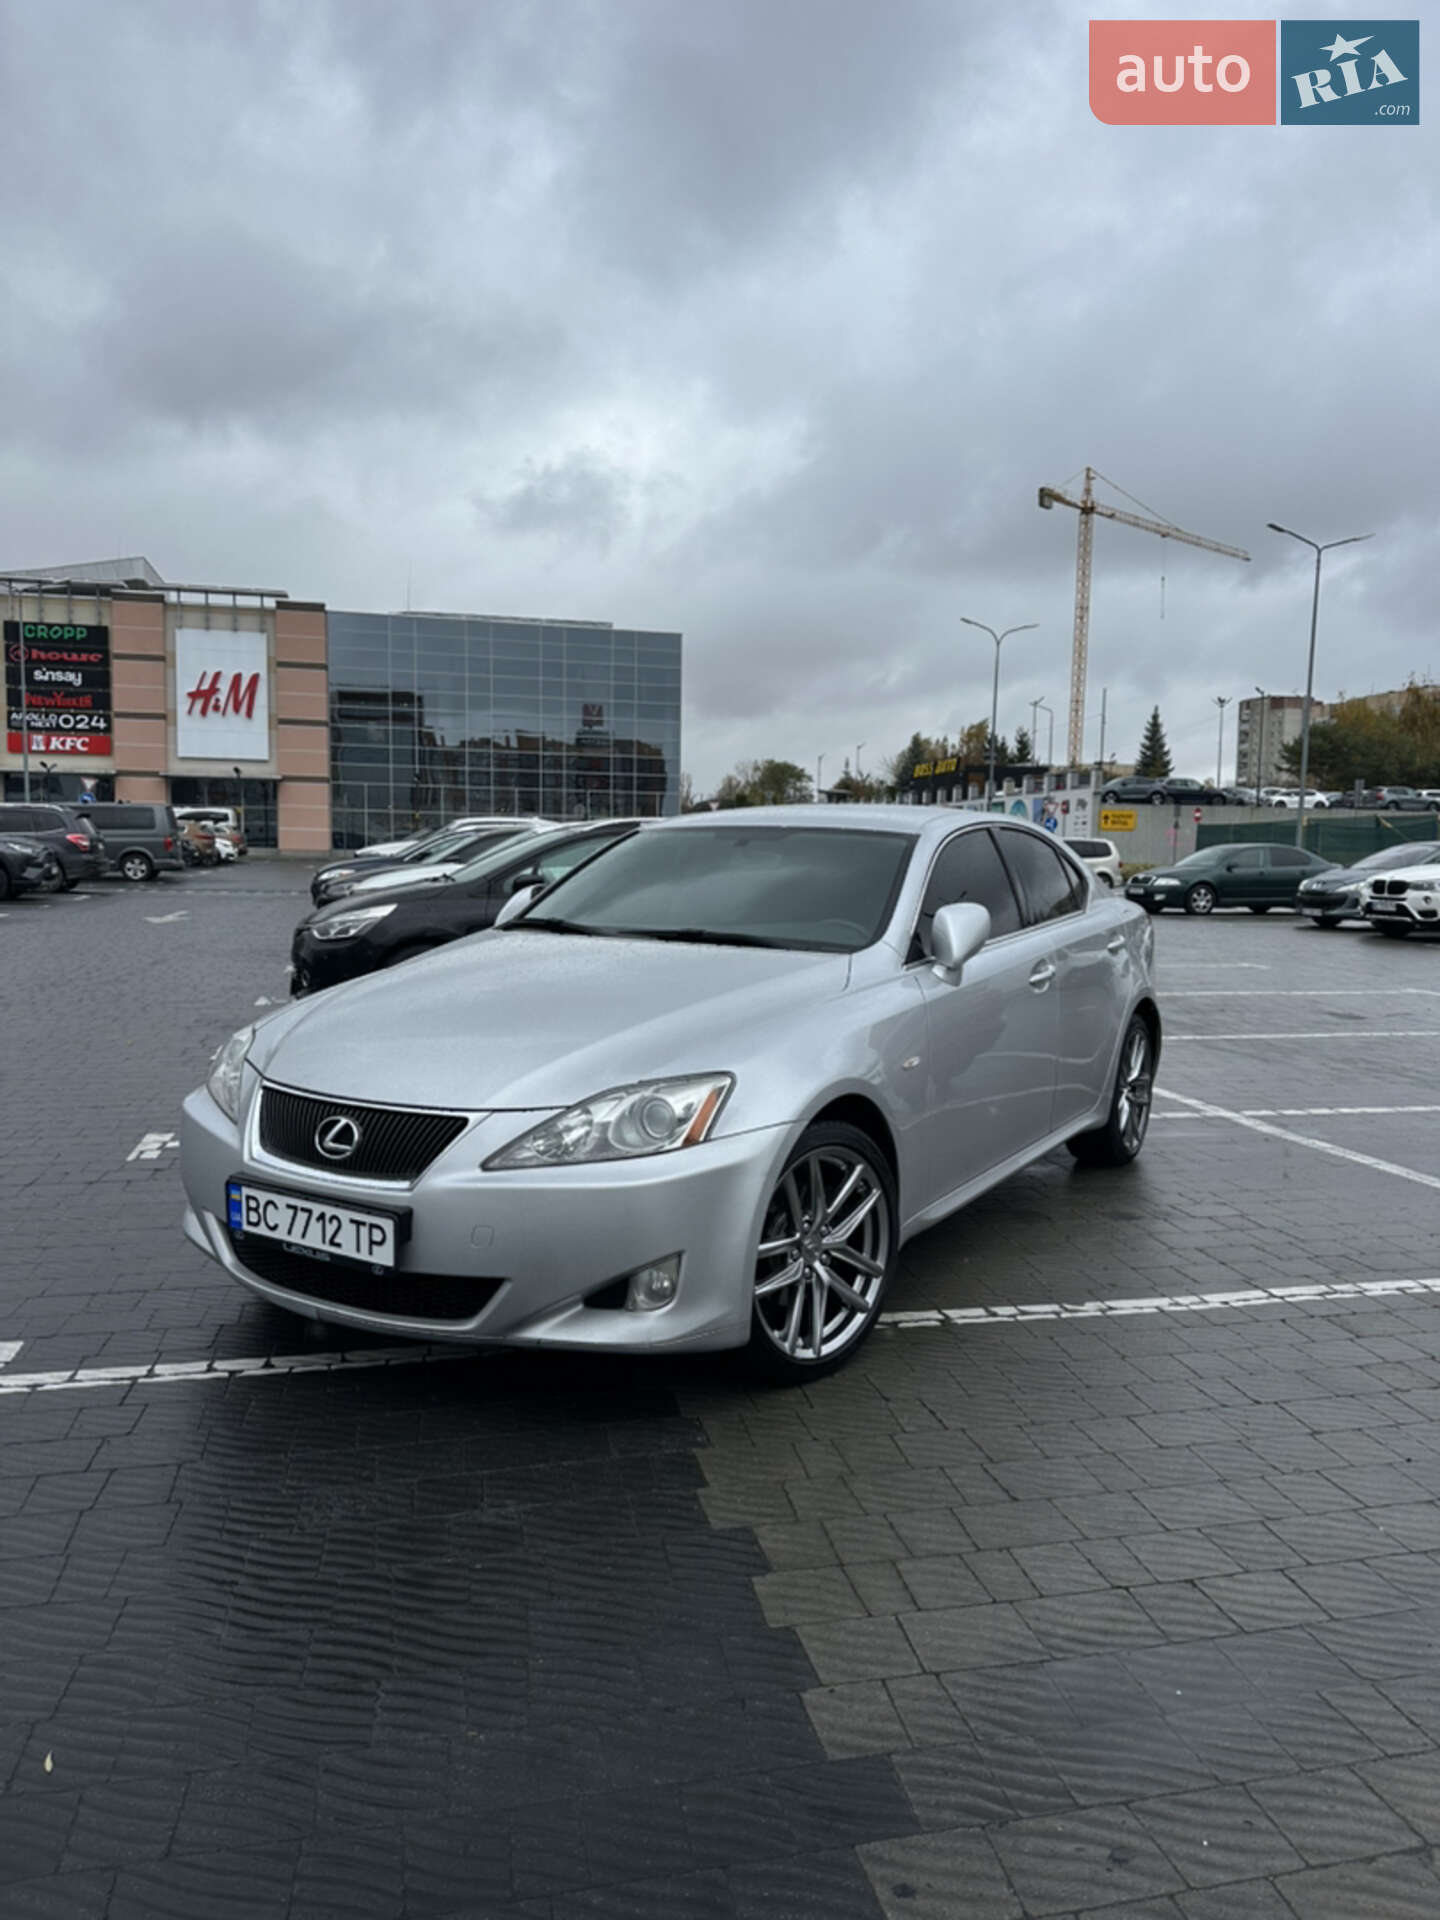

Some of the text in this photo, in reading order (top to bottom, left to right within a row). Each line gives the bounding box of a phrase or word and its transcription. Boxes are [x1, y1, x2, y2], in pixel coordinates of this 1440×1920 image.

[24, 625, 87, 640] CROPP
[33, 667, 82, 686] sinsay
[186, 670, 260, 719] H&M
[48, 736, 90, 751] KFC
[245, 1195, 387, 1256] BC 7712 TP
